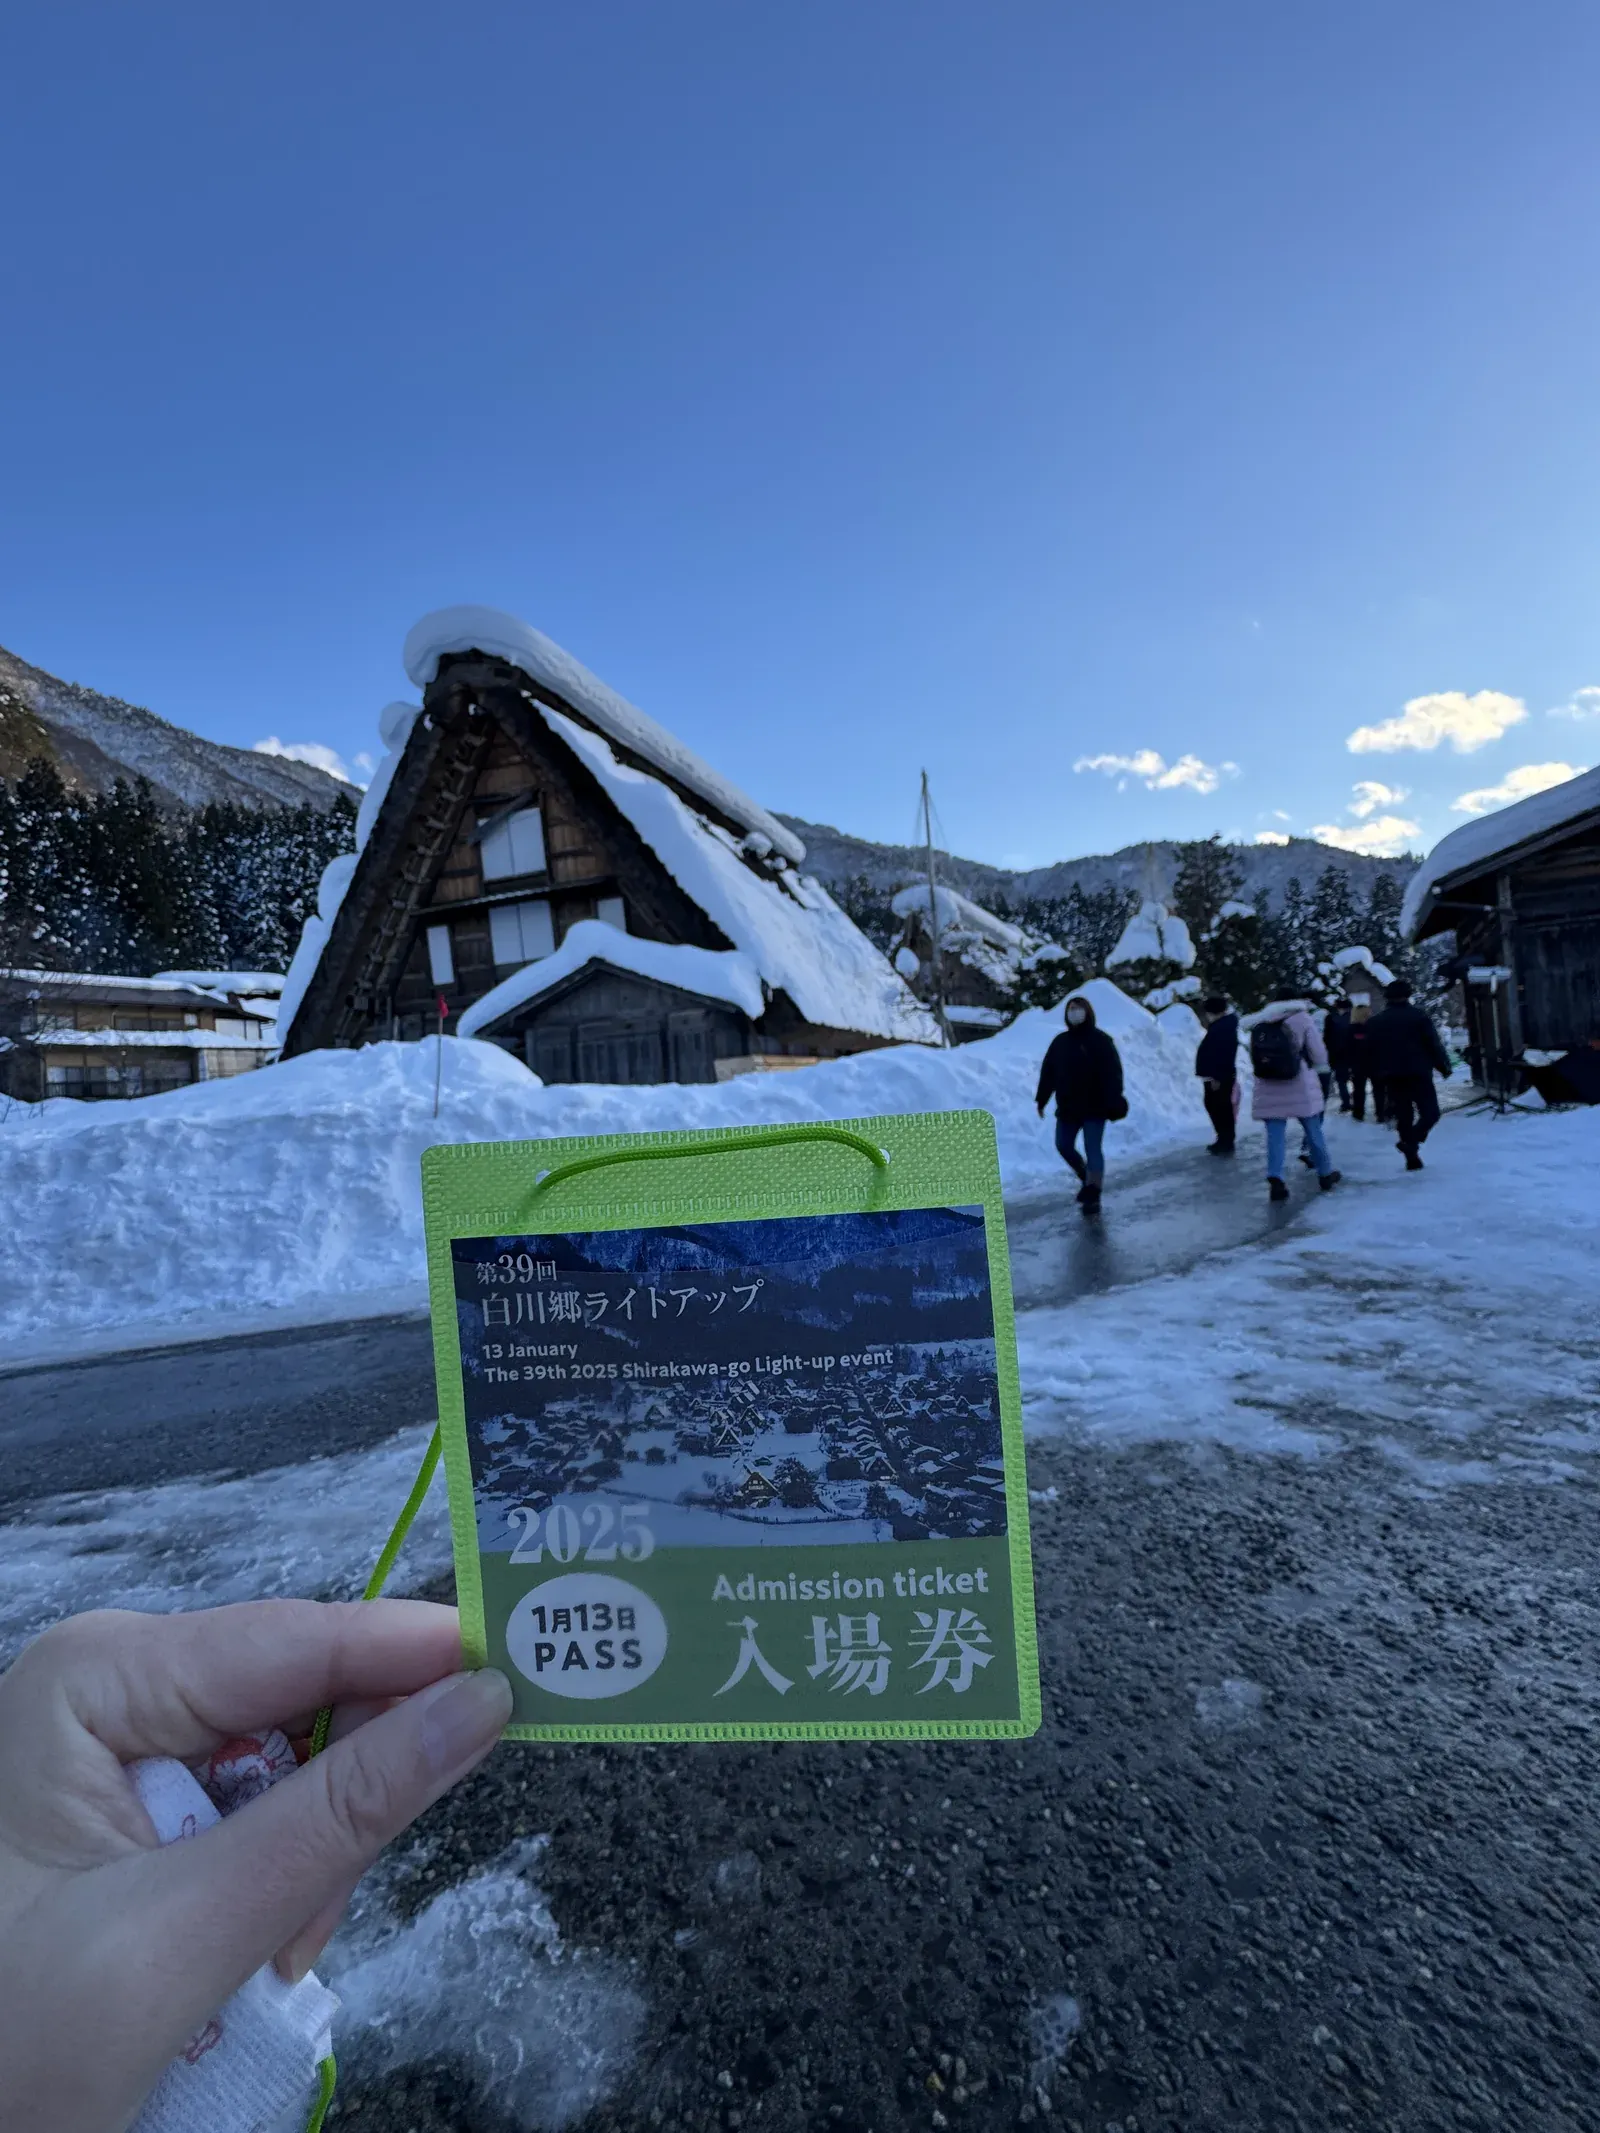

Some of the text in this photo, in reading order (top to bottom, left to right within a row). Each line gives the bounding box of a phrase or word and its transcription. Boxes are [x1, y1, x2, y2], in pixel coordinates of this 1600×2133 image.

[476, 1253, 558, 1285] 第39回
[482, 1278, 765, 1327] 白川郷ライトアップ
[483, 1343, 578, 1359] 13 January
[484, 1349, 894, 1383] The 39th 2025 Shirakawa-go Light-up event
[507, 1503, 655, 1564] 2025
[711, 1566, 989, 1601] Admission ticket
[531, 1603, 637, 1634] 1月13日
[534, 1638, 643, 1672] PASS
[712, 1607, 996, 1696] 入場券
